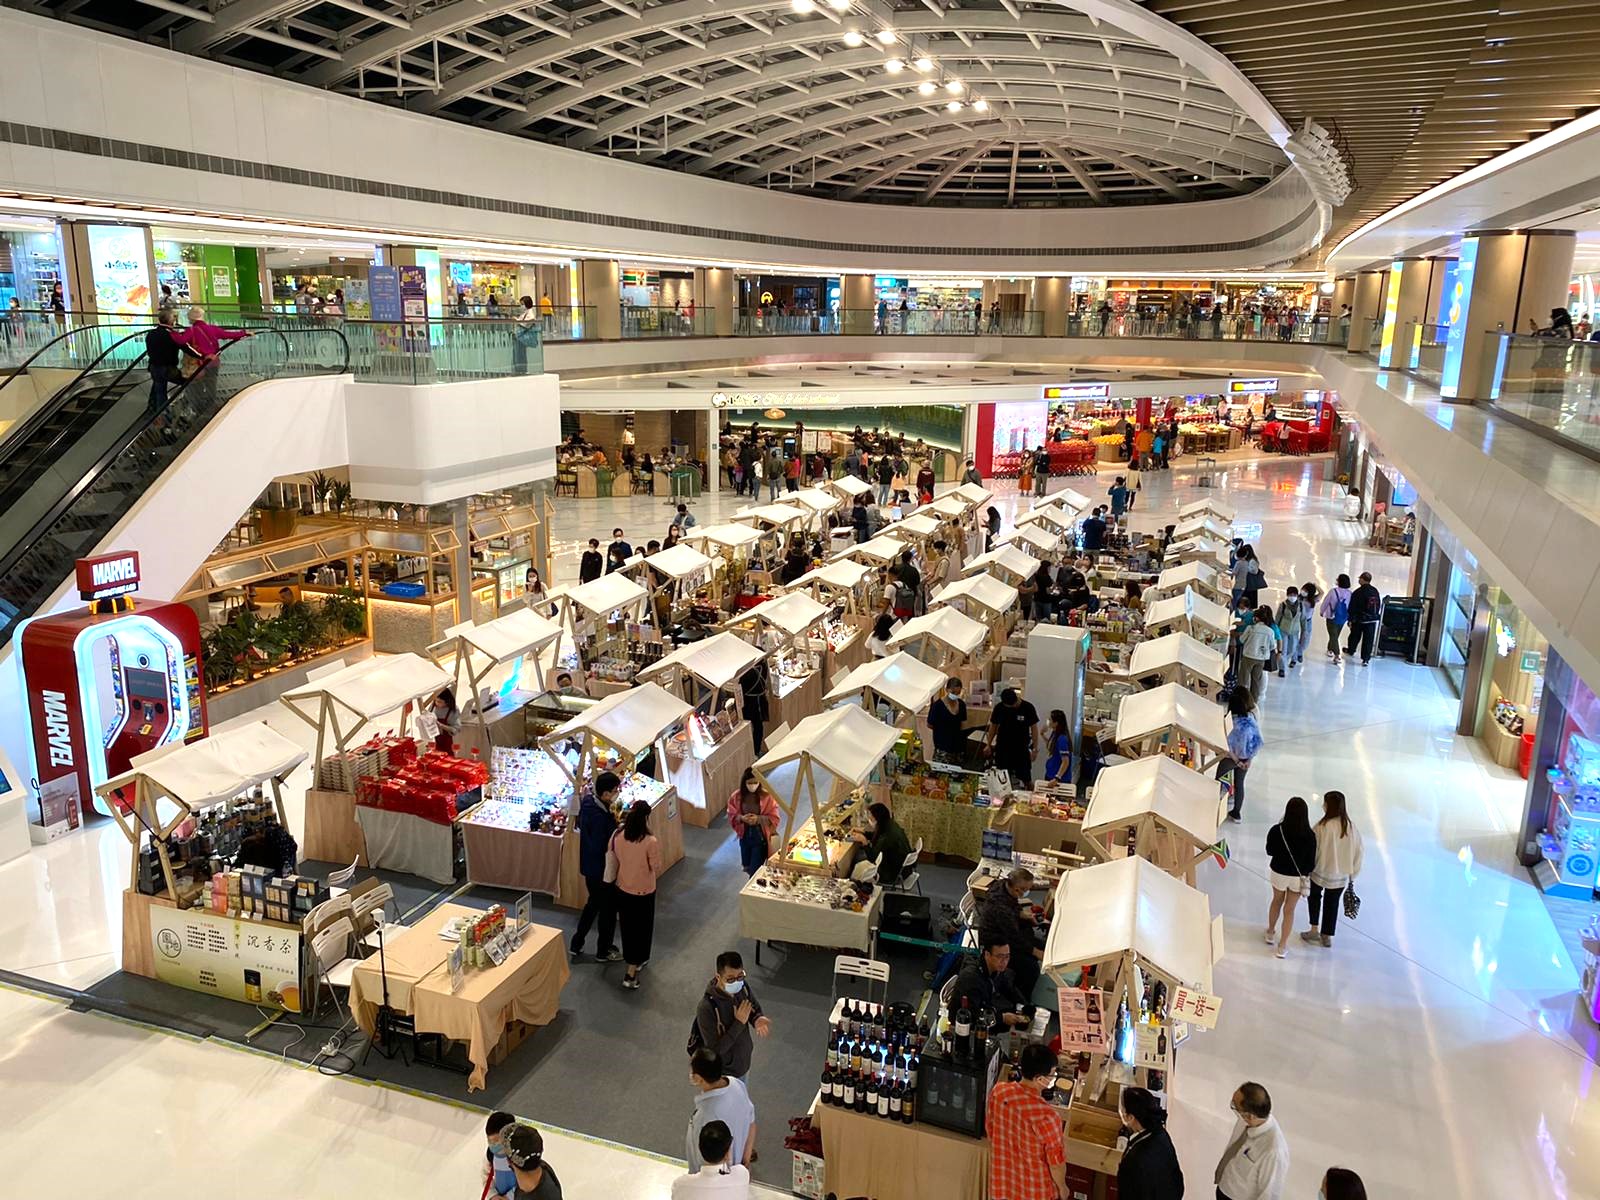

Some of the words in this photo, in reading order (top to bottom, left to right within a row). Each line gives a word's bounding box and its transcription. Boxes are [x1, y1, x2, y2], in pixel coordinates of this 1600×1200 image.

[92, 557, 137, 586] MARVEL
[42, 689, 74, 768] MARVEL
[247, 935, 292, 954] 沉香茶
[1174, 989, 1216, 1017] 買一送一
